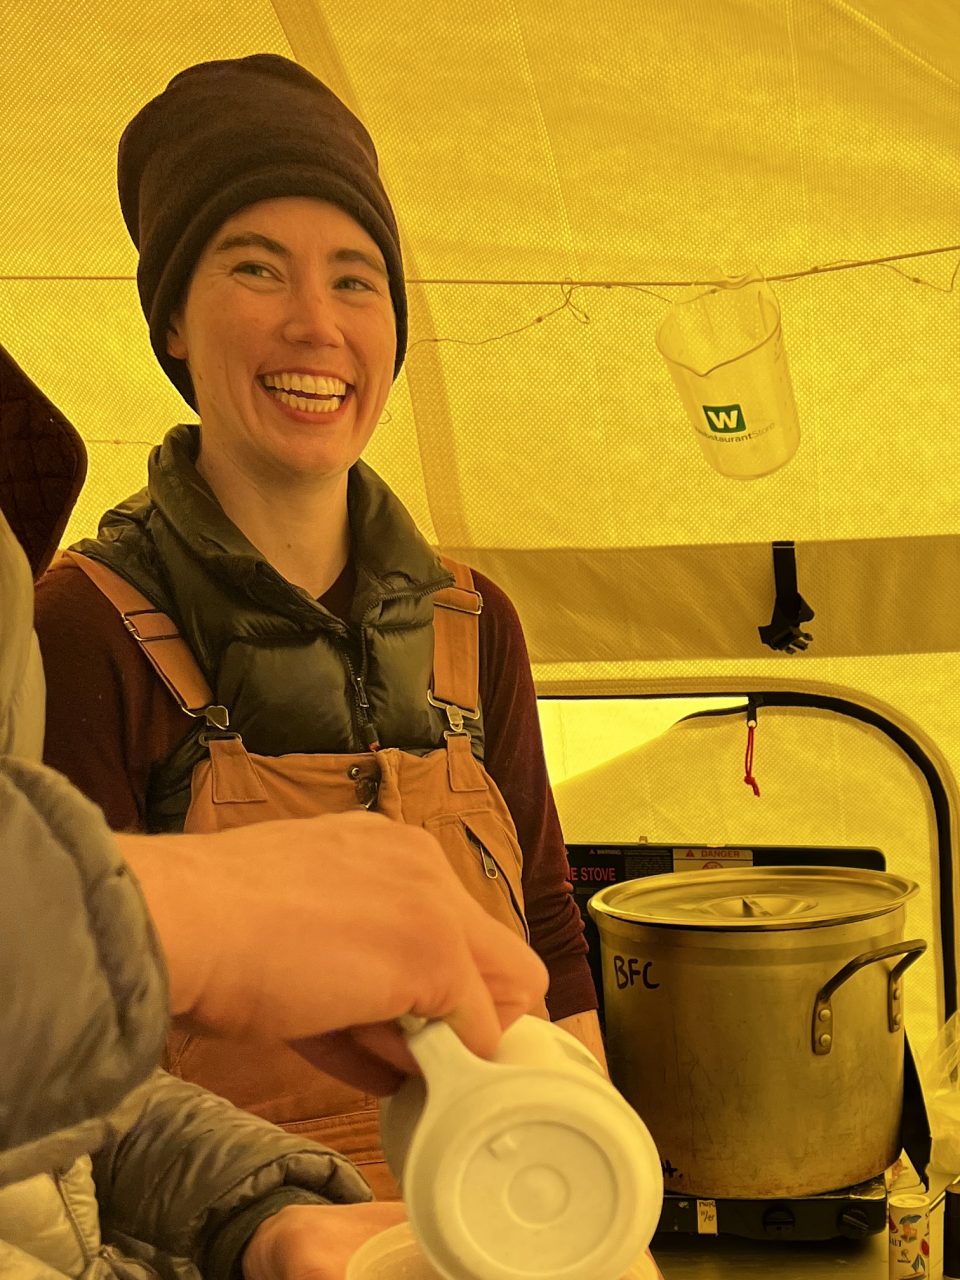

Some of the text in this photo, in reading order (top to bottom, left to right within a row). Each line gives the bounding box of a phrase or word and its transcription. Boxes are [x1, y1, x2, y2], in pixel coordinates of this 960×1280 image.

[707, 410, 739, 429] W
[701, 850, 740, 858] DANGER
[581, 867, 616, 882] STOVE
[614, 955, 660, 990] BFC
